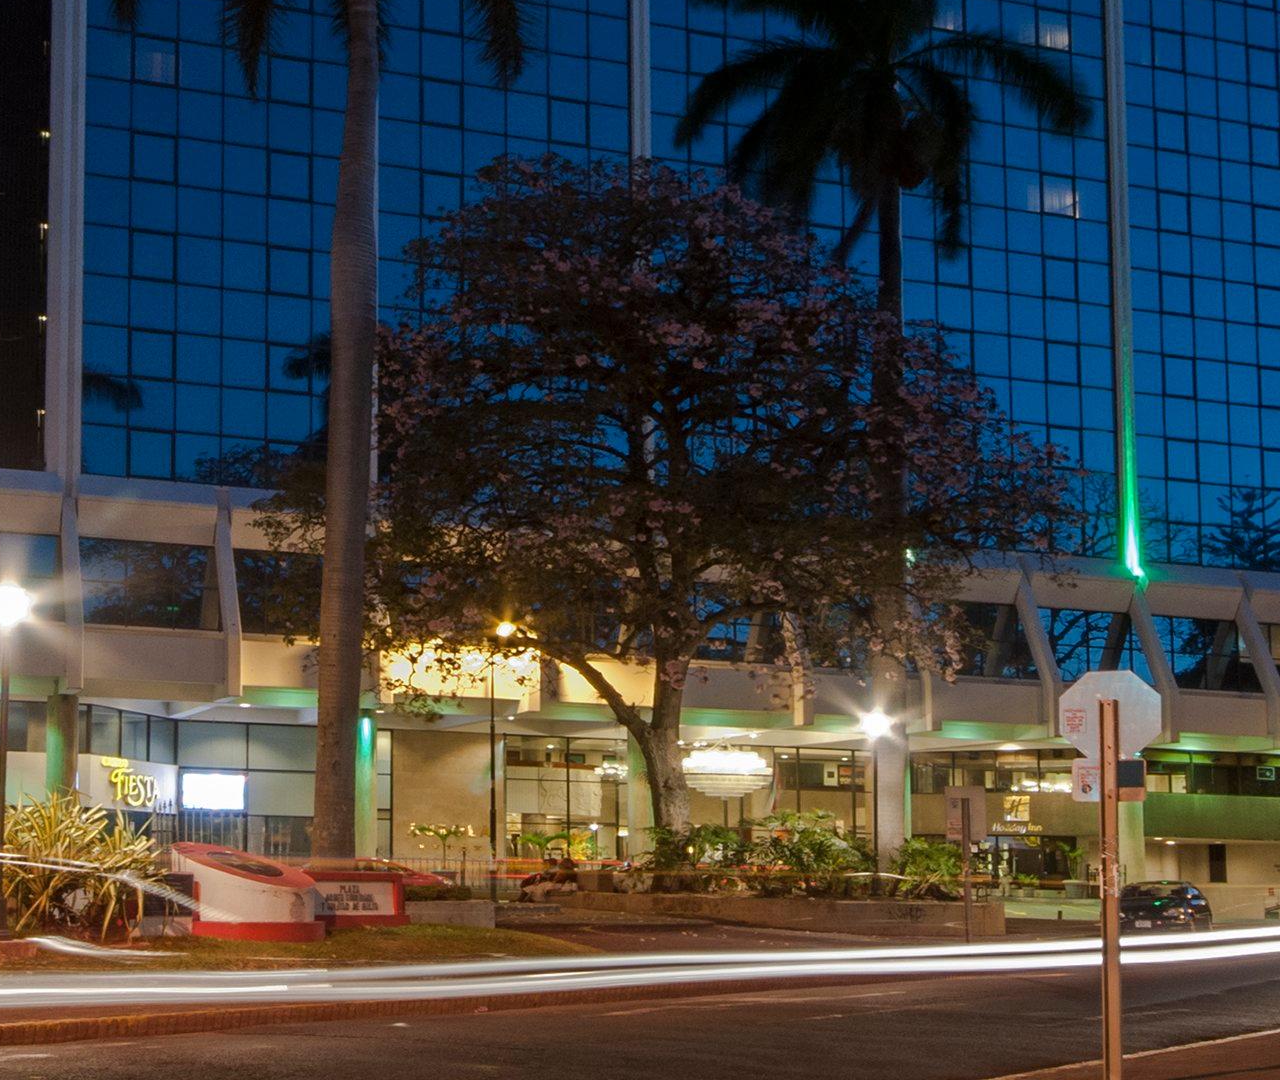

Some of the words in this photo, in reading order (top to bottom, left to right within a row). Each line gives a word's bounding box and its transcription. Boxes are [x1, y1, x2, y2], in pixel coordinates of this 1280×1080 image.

[110, 768, 160, 807] FIESTA
[992, 822, 1026, 834] Holiday
[1028, 823, 1042, 831] Inn
